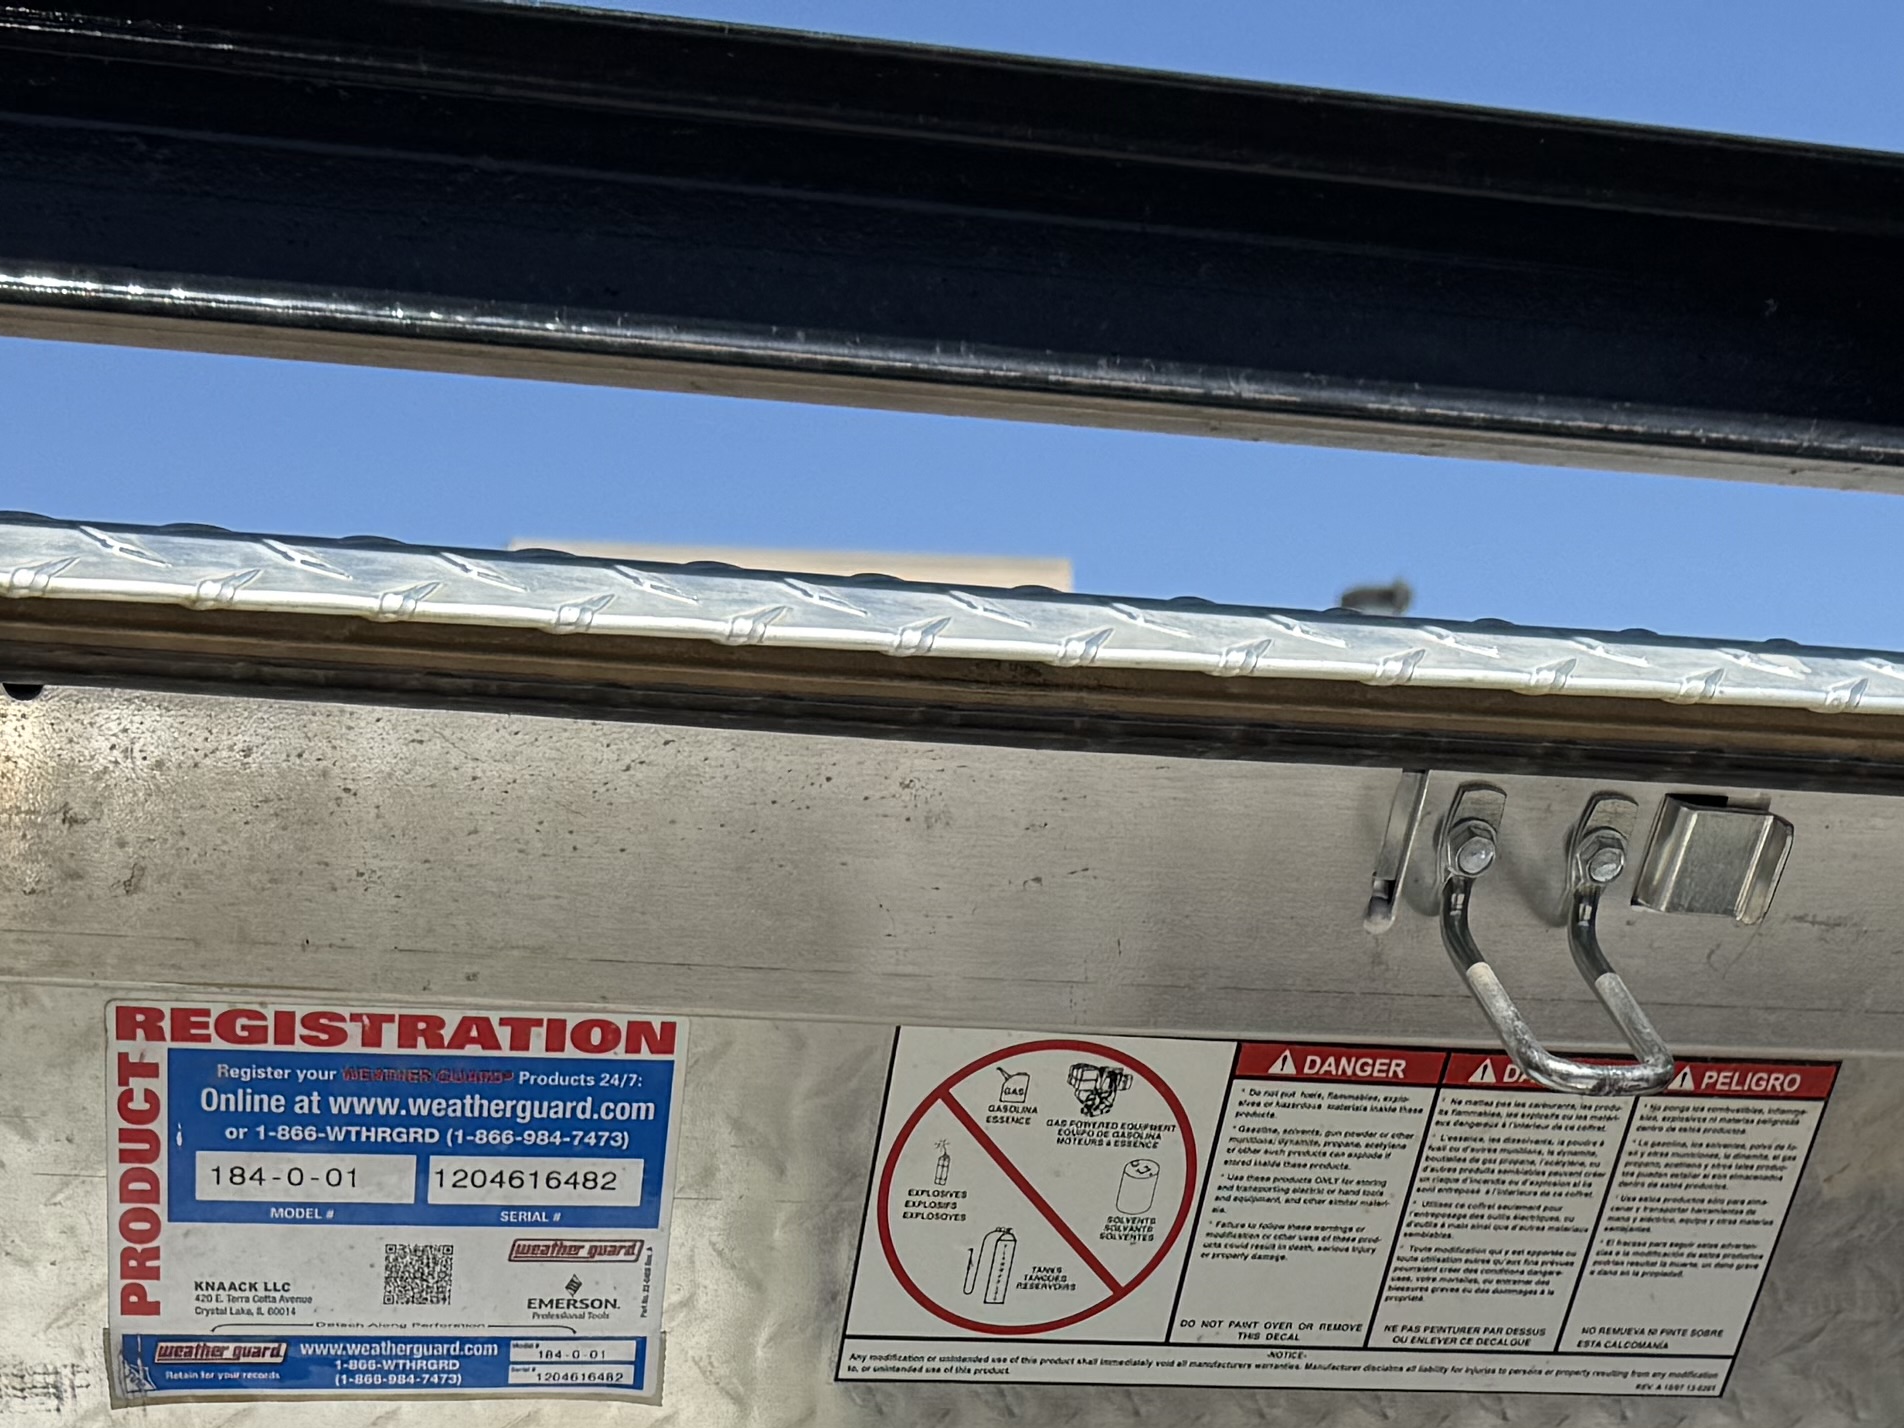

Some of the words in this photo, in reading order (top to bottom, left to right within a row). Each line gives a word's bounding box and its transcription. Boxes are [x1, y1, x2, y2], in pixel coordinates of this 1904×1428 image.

[116, 1006, 677, 1055] REGISTRATION
[1305, 1055, 1406, 1078] DANGER
[217, 1064, 291, 1081] Register
[296, 1069, 337, 1082] your
[519, 1071, 595, 1086] Products
[599, 1074, 643, 1087] 24/7:
[1700, 1070, 1801, 1092] PELIGRO
[201, 1087, 285, 1113] Online
[295, 1092, 320, 1114] at
[330, 1094, 655, 1123] www.weatherguard.com
[988, 1105, 1038, 1114] GASOLINA
[986, 1116, 1031, 1125] ESSENCE
[225, 1127, 247, 1139] or
[256, 1126, 440, 1143] 1-866-WTHRGRD
[446, 1129, 629, 1149] (1-866-984-7473)
[1112, 1132, 1162, 1140] GASOLINA
[1114, 1141, 1159, 1149] ESSENCE
[211, 1166, 357, 1188] 184-0-01
[435, 1169, 617, 1191] 1204616482
[117, 1051, 161, 1316] PRODUCT
[908, 1189, 967, 1198] EXPLOSIVES
[905, 1200, 957, 1209] EXPLOSIFS
[271, 1207, 322, 1219] MODEL
[326, 1207, 335, 1219] #
[500, 1211, 548, 1222] SERIAL
[553, 1212, 561, 1222] #
[514, 1241, 584, 1256] weather
[588, 1242, 637, 1257] guard
[194, 1281, 258, 1292] KNAACK
[264, 1282, 291, 1292] LLC
[194, 1294, 212, 1303] 420
[216, 1295, 224, 1303] E.
[227, 1295, 250, 1304] Terra
[253, 1295, 276, 1304] Cotta
[279, 1295, 312, 1304] Avenue
[194, 1306, 227, 1317] Crystal
[230, 1306, 253, 1316] Lake,
[268, 1306, 296, 1316] 60014
[532, 1312, 585, 1320] Professional
[1229, 1321, 1259, 1329] PAINT
[1264, 1322, 1292, 1330] OVER
[1319, 1323, 1363, 1332] REMOVE
[1385, 1324, 1399, 1333] NE
[1402, 1325, 1421, 1334] PAS
[1424, 1325, 1481, 1335] PEINTURER
[1484, 1326, 1503, 1335] PAR
[1506, 1327, 1546, 1336] DESSUS
[1238, 1332, 1260, 1340] THIS
[1266, 1333, 1300, 1341] DECAL
[159, 1344, 228, 1359] weather
[300, 1340, 498, 1358] www.weatherguard.com
[335, 1360, 460, 1371] 1-866-WTHRGRD
[165, 1371, 198, 1380] Retain
[200, 1371, 215, 1380] for
[218, 1372, 240, 1380] your
[243, 1371, 280, 1380] records
[335, 1373, 462, 1386] (1-866-984-7473)
[537, 1373, 623, 1382] 1204616482
